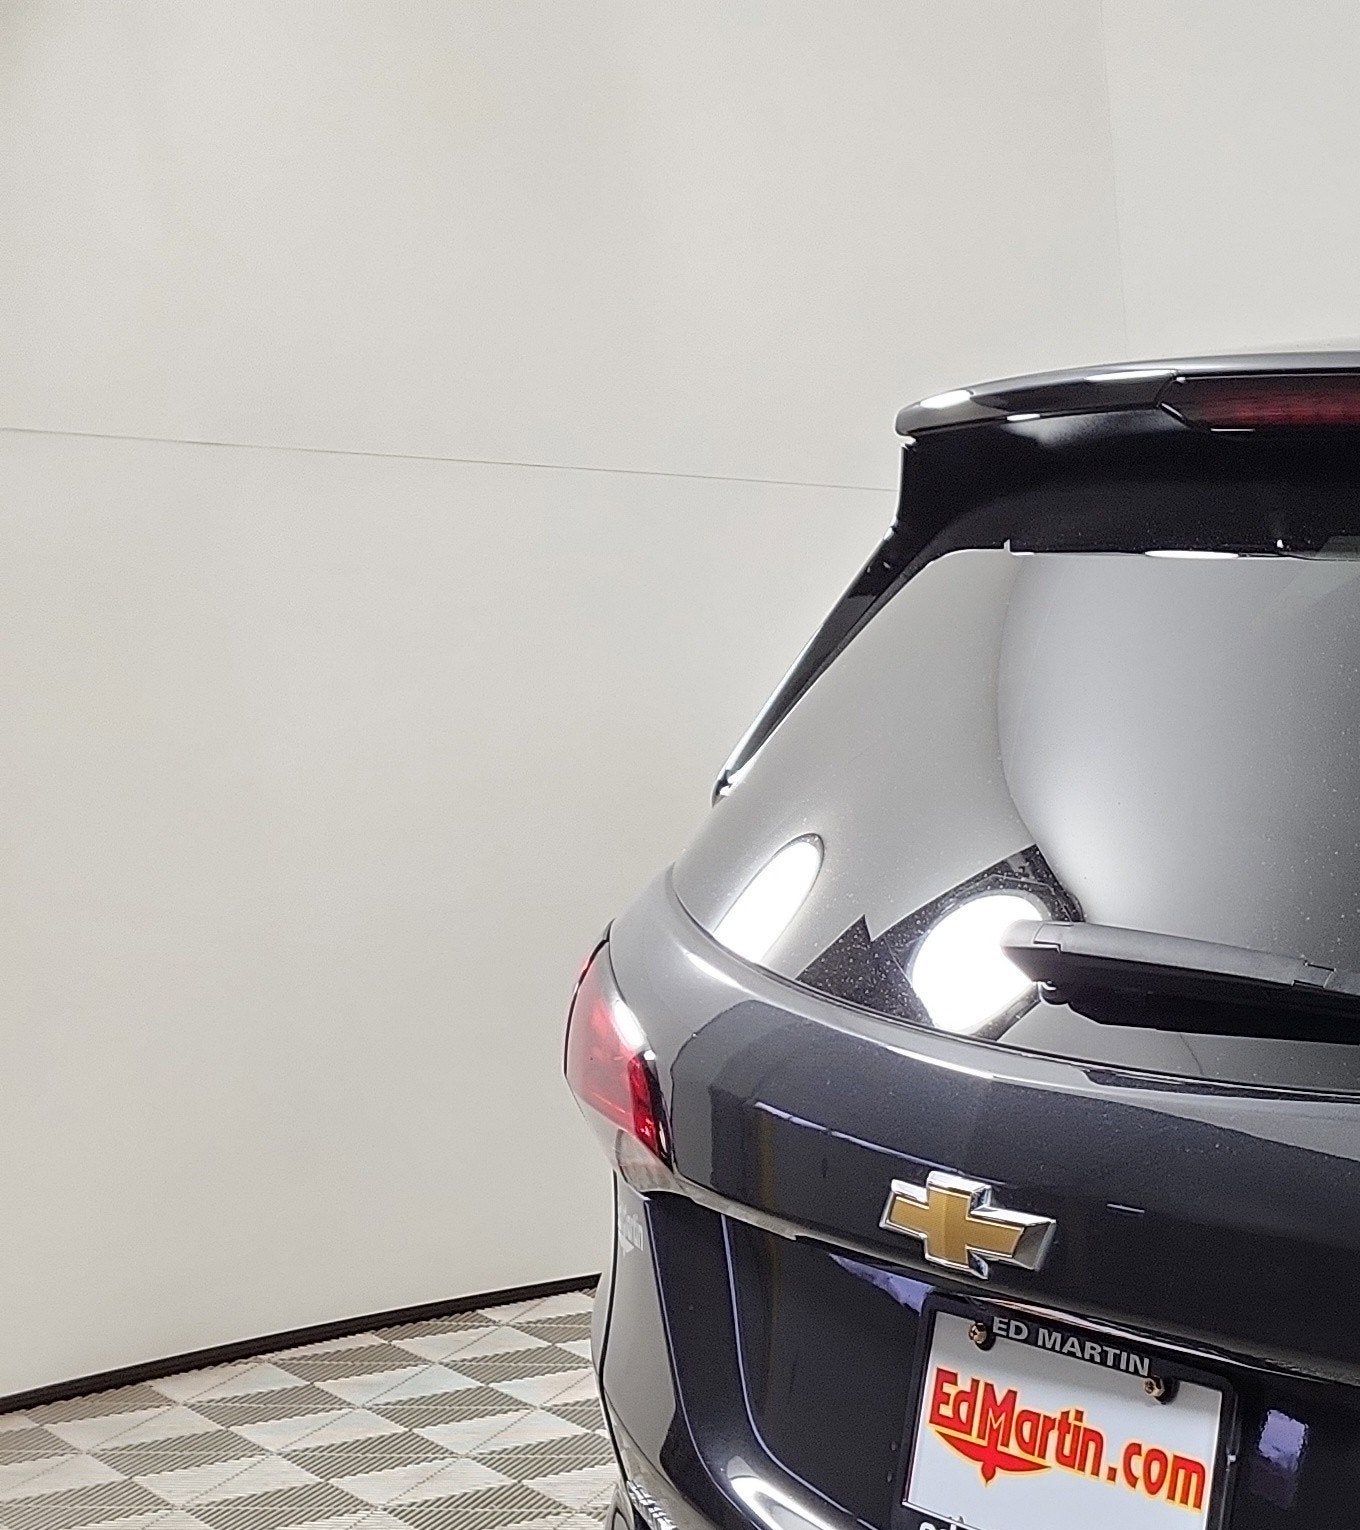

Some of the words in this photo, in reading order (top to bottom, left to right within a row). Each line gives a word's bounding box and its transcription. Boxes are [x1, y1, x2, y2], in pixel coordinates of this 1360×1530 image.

[992, 1316, 1029, 1342] ED
[1037, 1330, 1151, 1378] MARTIN
[928, 1366, 1206, 1512] EdMartin.com
